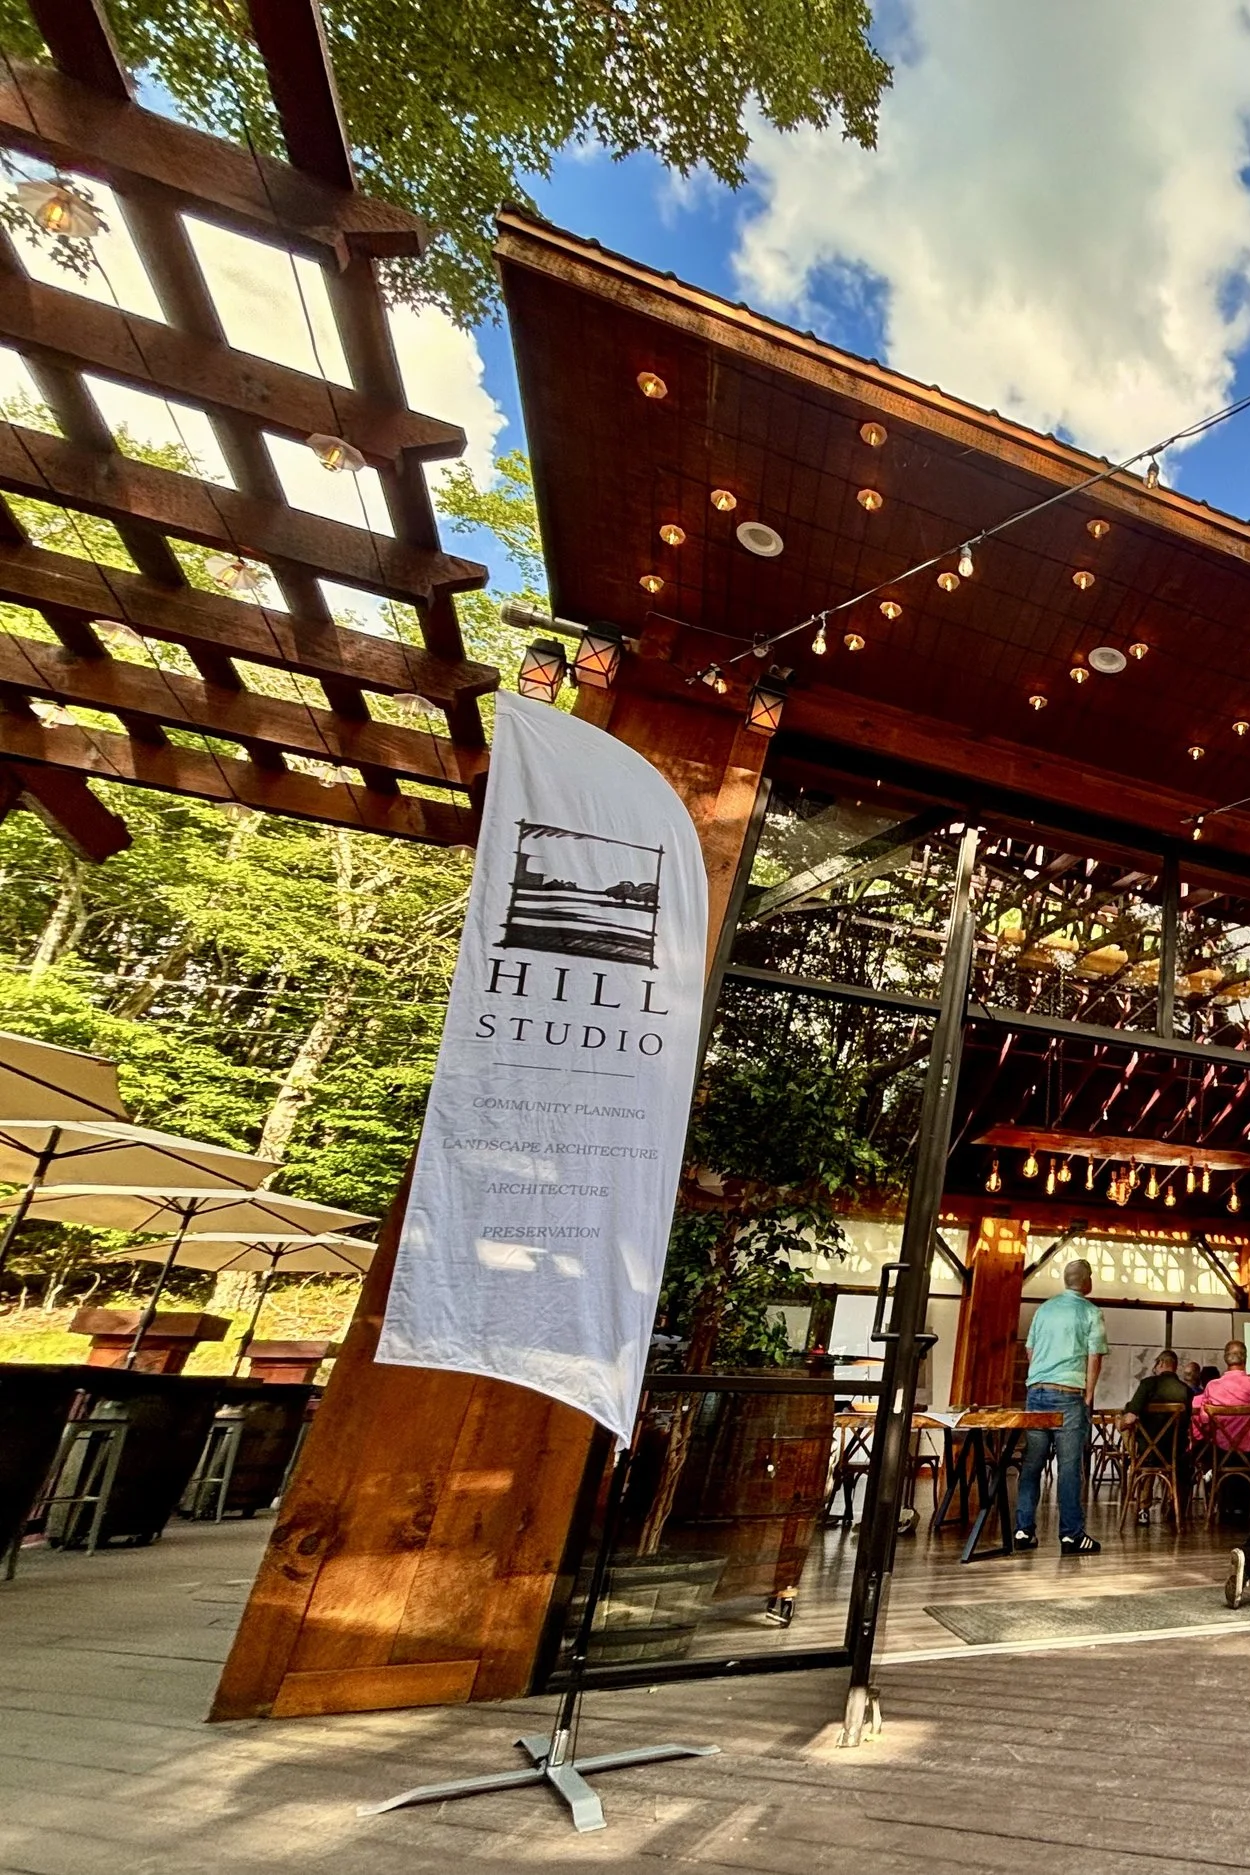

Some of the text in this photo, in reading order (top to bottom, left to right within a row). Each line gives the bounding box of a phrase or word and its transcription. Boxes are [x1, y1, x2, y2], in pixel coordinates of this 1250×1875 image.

[484, 957, 669, 1016] HILL
[475, 1013, 664, 1056] STUDIO
[472, 1096, 646, 1120] COMMUNITY PLANNING
[442, 1137, 659, 1160] LANDSCAPE ARCHITECTURE
[486, 1182, 610, 1198] ARCHITECTURE
[481, 1225, 601, 1240] PRESERVATION
